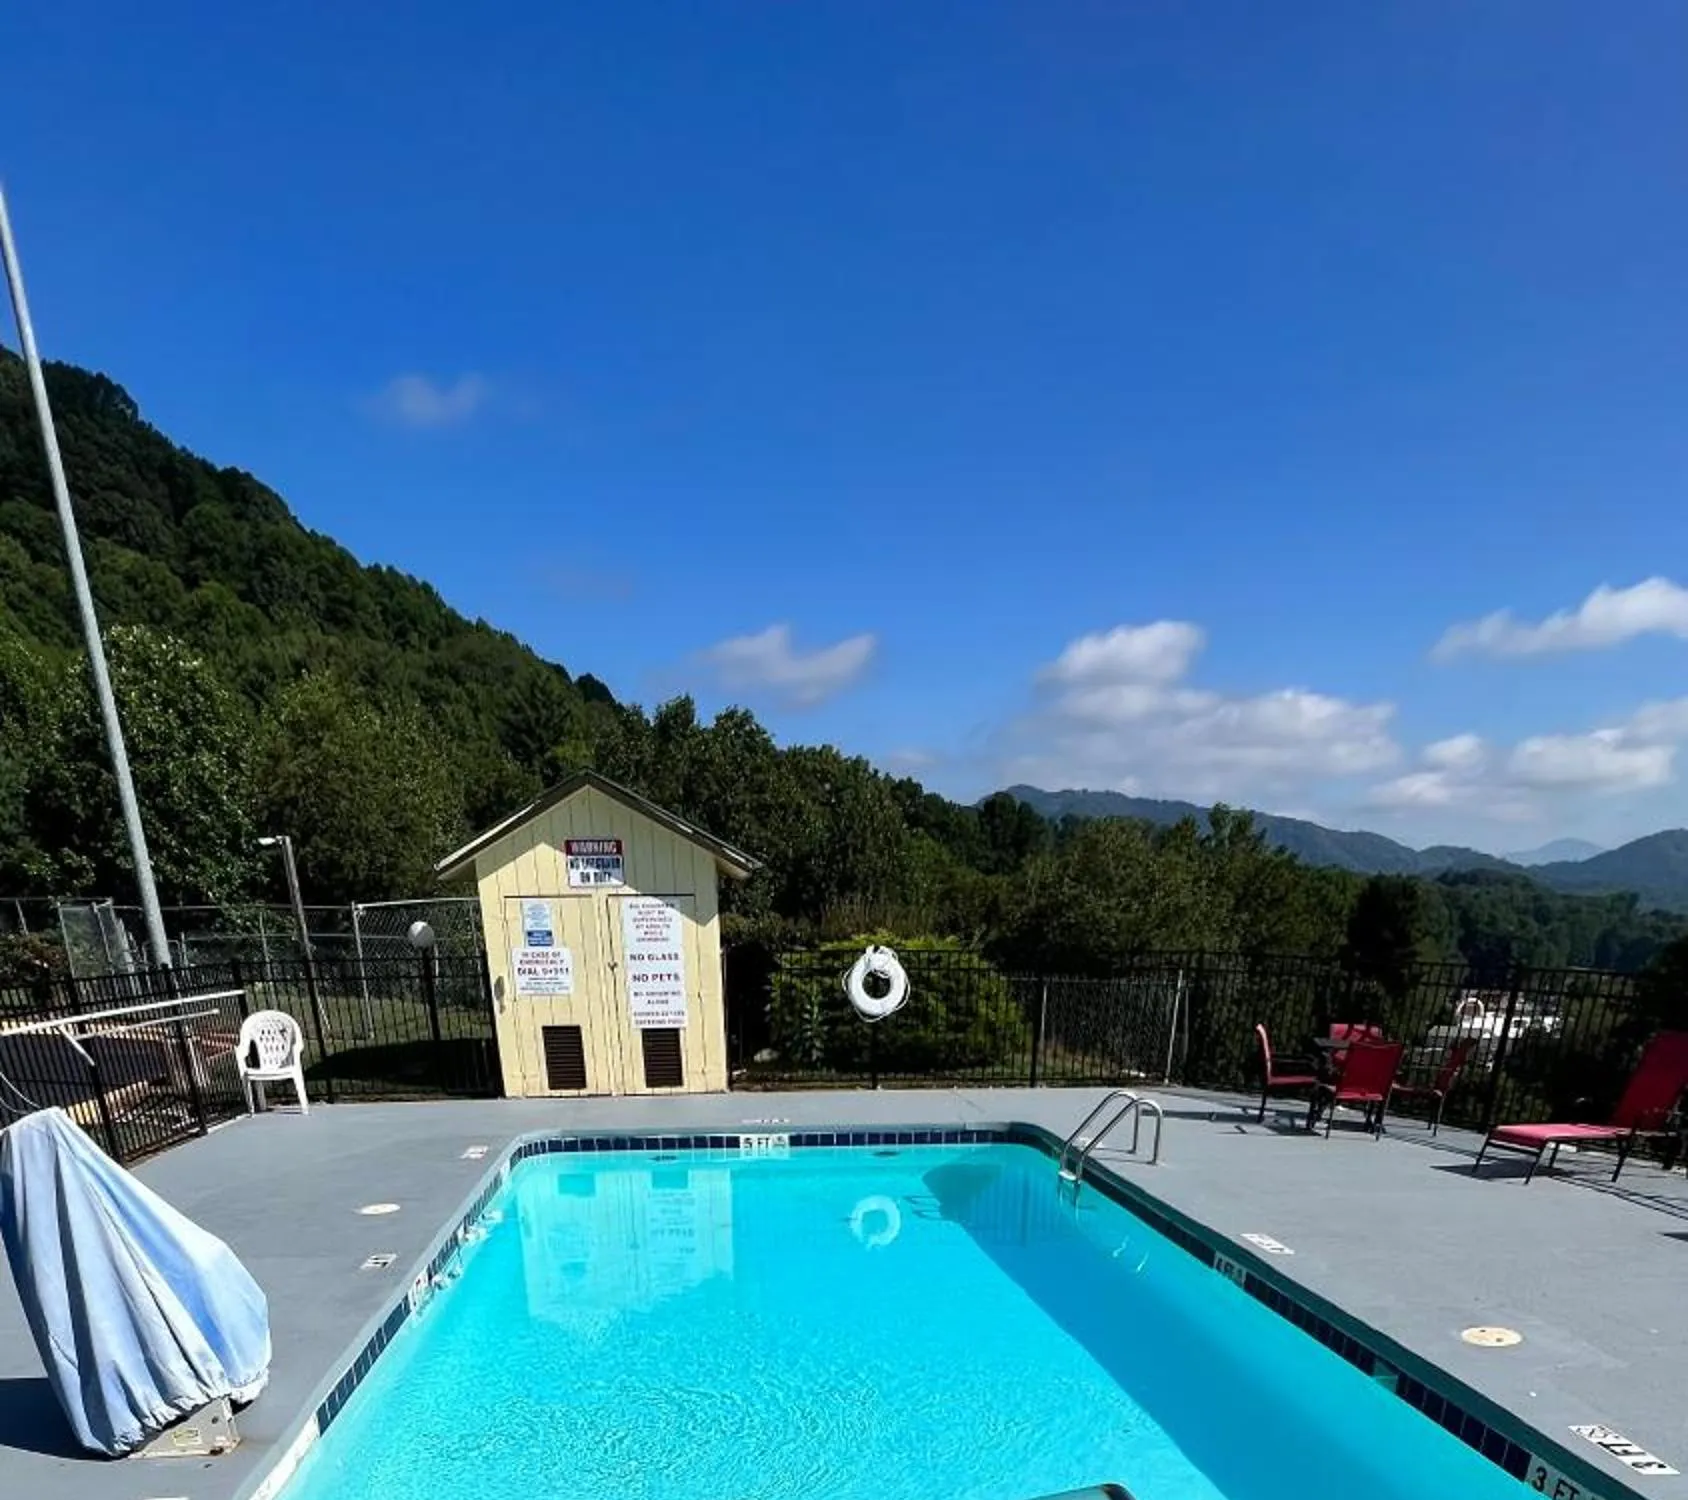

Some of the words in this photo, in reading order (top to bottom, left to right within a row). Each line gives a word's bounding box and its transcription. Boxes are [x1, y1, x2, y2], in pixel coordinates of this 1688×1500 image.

[629, 953, 645, 961] NO
[647, 952, 679, 961] GLASS
[632, 974, 649, 982] NO
[651, 972, 680, 982] PETS
[757, 1137, 769, 1147] FT
[1598, 1442, 1646, 1456] FT
[1531, 1466, 1547, 1493] 3
